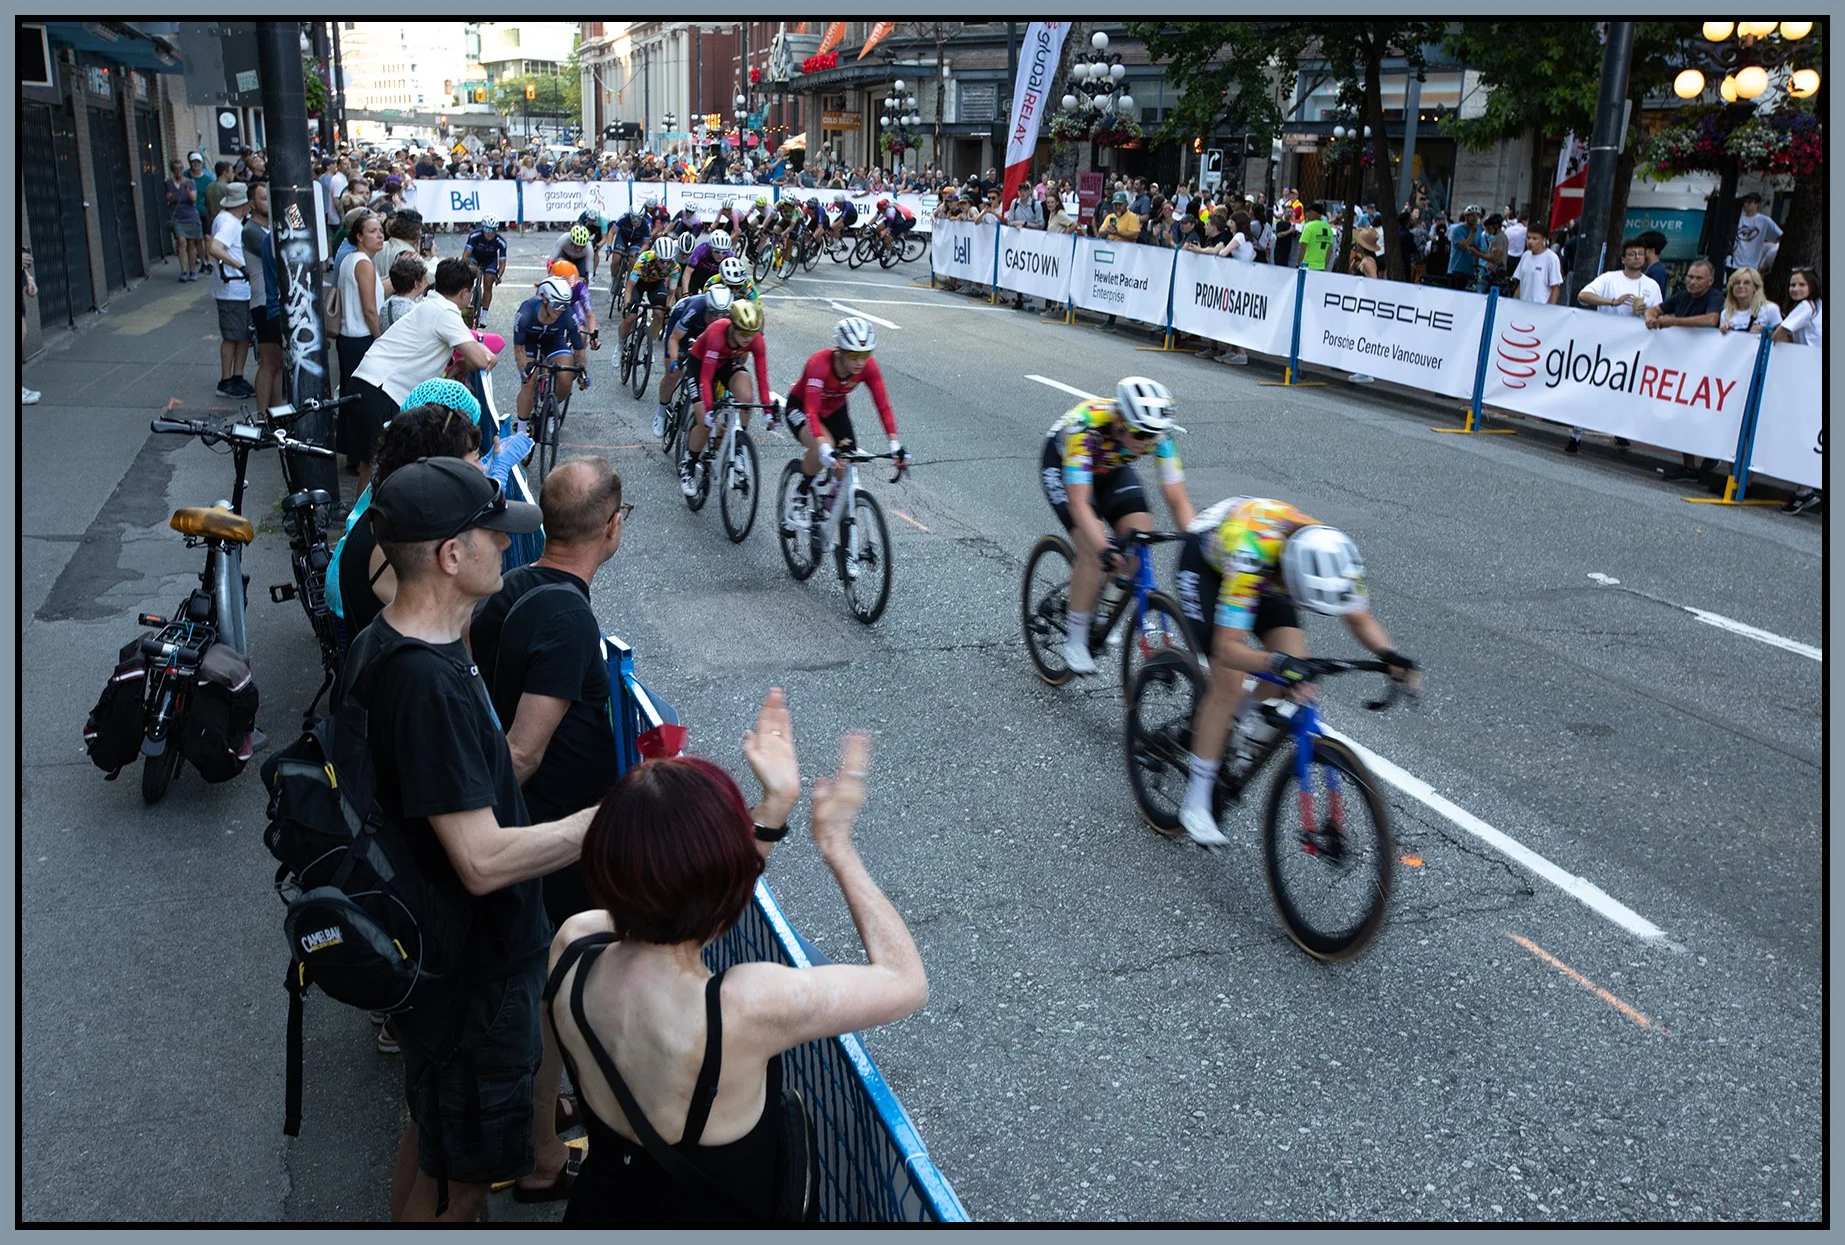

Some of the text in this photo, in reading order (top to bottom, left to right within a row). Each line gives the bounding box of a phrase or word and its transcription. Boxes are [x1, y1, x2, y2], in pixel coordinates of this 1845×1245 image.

[450, 190, 480, 211] Bell
[544, 190, 582, 201] gastown
[546, 200, 571, 211] grand
[681, 191, 758, 201] PORSCHE
[1005, 248, 1060, 278] GASTOWN
[1093, 268, 1119, 286] Hewlett
[1092, 284, 1126, 304] Enterprise
[1195, 281, 1268, 321] PROMOSAPIEN
[1323, 292, 1454, 331] PORSCHE
[1322, 329, 1443, 370] Porsche Centre Vancouver
